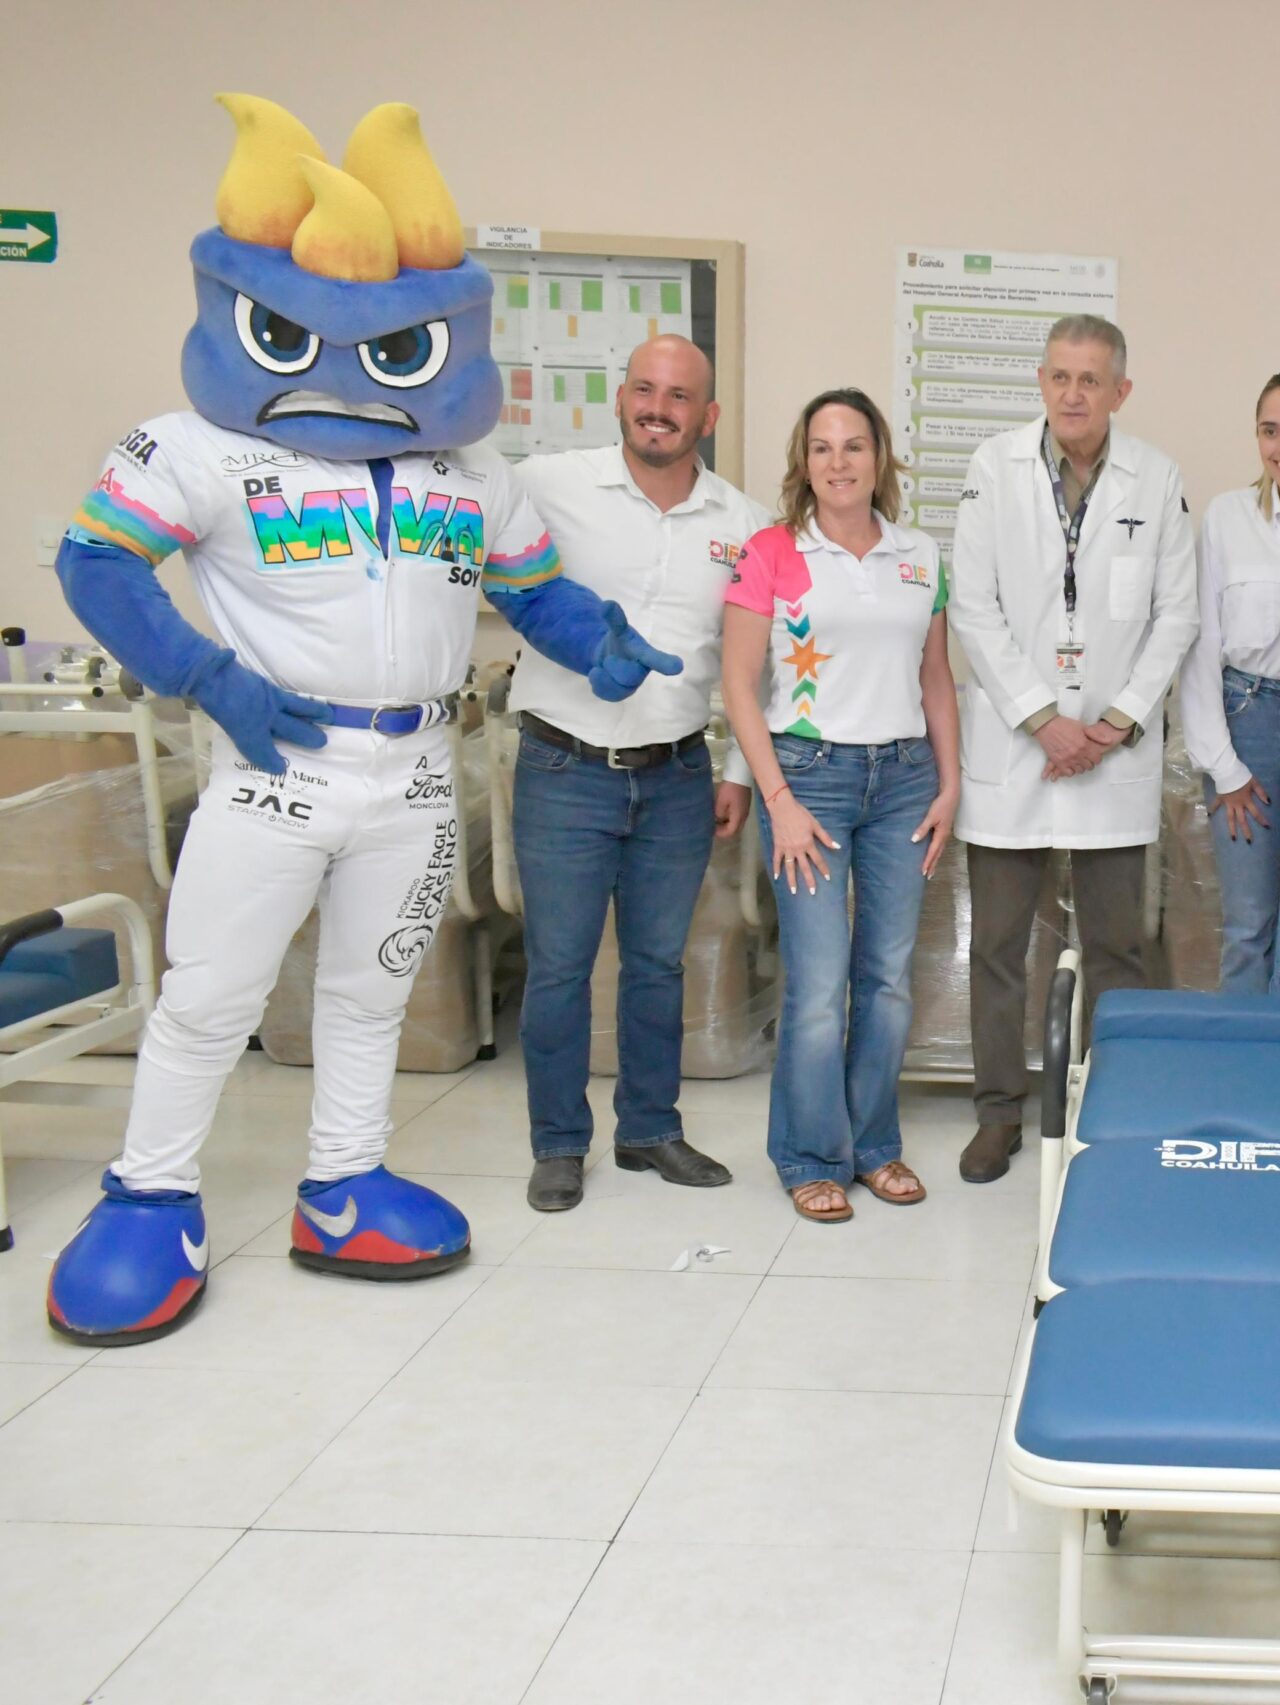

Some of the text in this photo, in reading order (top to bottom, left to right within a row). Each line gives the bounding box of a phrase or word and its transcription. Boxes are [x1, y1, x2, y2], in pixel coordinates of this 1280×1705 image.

[486, 241, 532, 249] INDICADORES
[242, 475, 283, 497] DE
[246, 487, 484, 566] MVA
[448, 566, 481, 588] SOY
[898, 563, 928, 581] DIF
[405, 774, 453, 800] Ford
[227, 804, 309, 829] START NOW
[231, 788, 313, 820] JAC
[405, 820, 447, 920] LUCKY EAGLE
[424, 819, 457, 920] CASINO
[396, 878, 421, 919] KICKAPOO
[1160, 1160, 1280, 1172] COAHUILA
